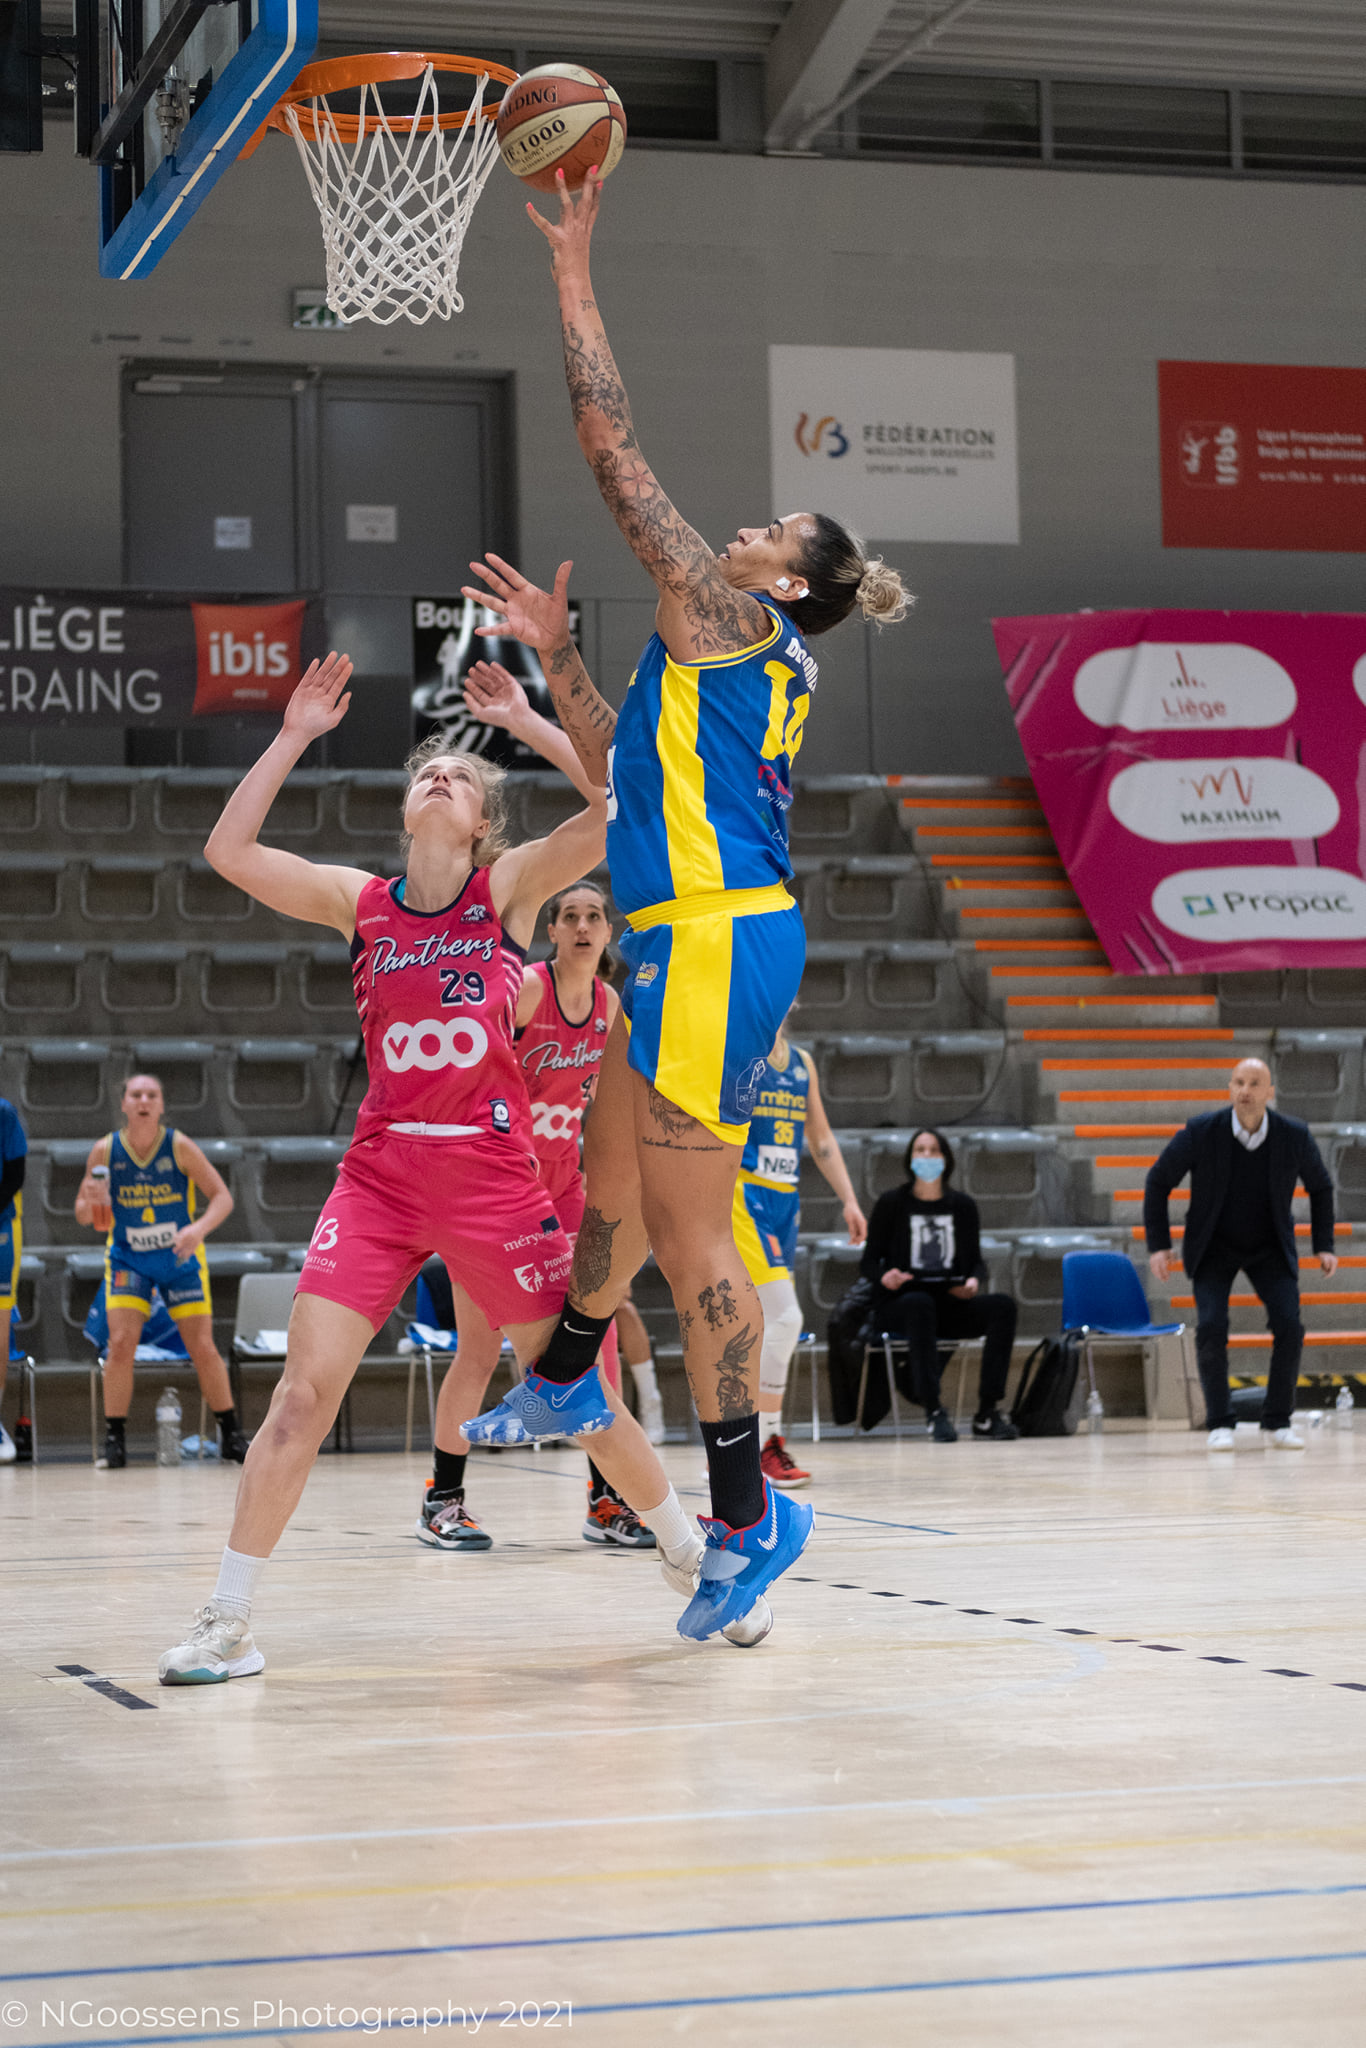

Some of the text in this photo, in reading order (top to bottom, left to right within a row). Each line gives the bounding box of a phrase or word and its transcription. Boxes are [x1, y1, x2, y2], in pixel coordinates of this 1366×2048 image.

[862, 421, 995, 446] FÉDÉRATION
[209, 632, 290, 677] ibis
[1161, 697, 1227, 720] Liège
[1180, 809, 1281, 825] MAXIMUM
[1224, 891, 1354, 917] Propac
[369, 930, 497, 988] Panthers
[439, 968, 487, 1007] 29
[773, 1120, 795, 1145] 35
[141, 1207, 156, 1224] 4
[549, 1271, 561, 1282] de
